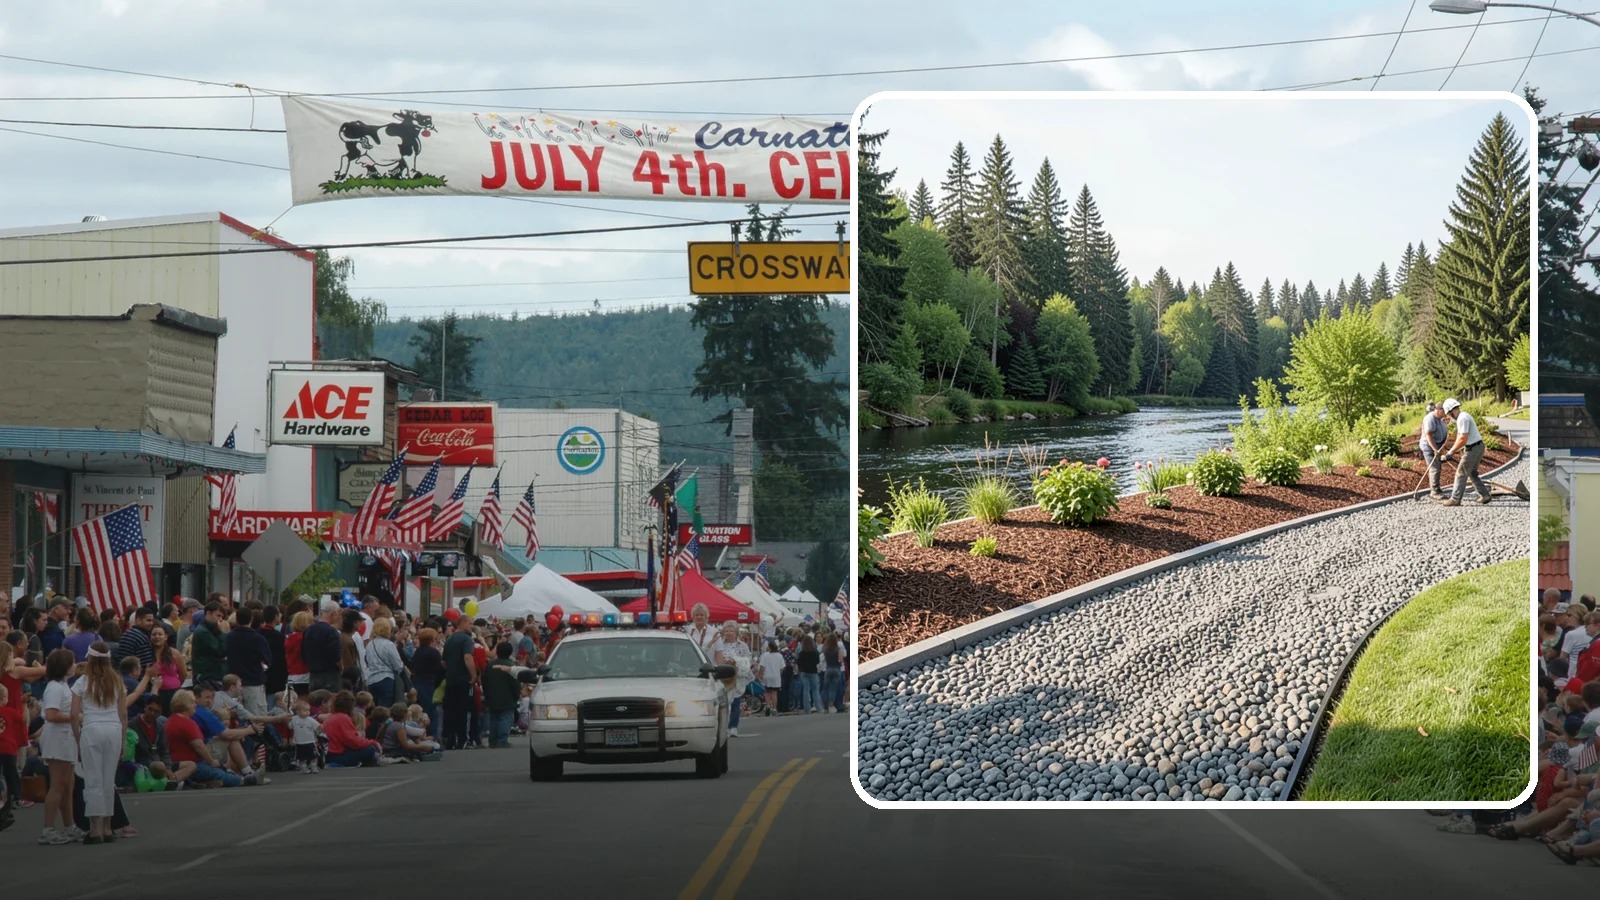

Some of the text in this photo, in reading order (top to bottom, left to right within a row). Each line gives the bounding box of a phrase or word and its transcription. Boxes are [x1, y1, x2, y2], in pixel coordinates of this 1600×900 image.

[481, 141, 604, 193] JULY
[633, 150, 746, 199] 4th.
[697, 254, 850, 280] CROSSWA
[283, 380, 374, 420] ACE
[405, 409, 452, 422] CEDAR
[283, 421, 371, 437] Hardware
[416, 427, 477, 447] Coca-Cola
[354, 467, 385, 481] Simpl
[83, 485, 155, 495] St. Vincent de Paul
[81, 503, 154, 522] THT
[212, 516, 330, 535] HARDARE
[688, 526, 742, 535] CRNATION
[699, 535, 731, 543] GLASS
